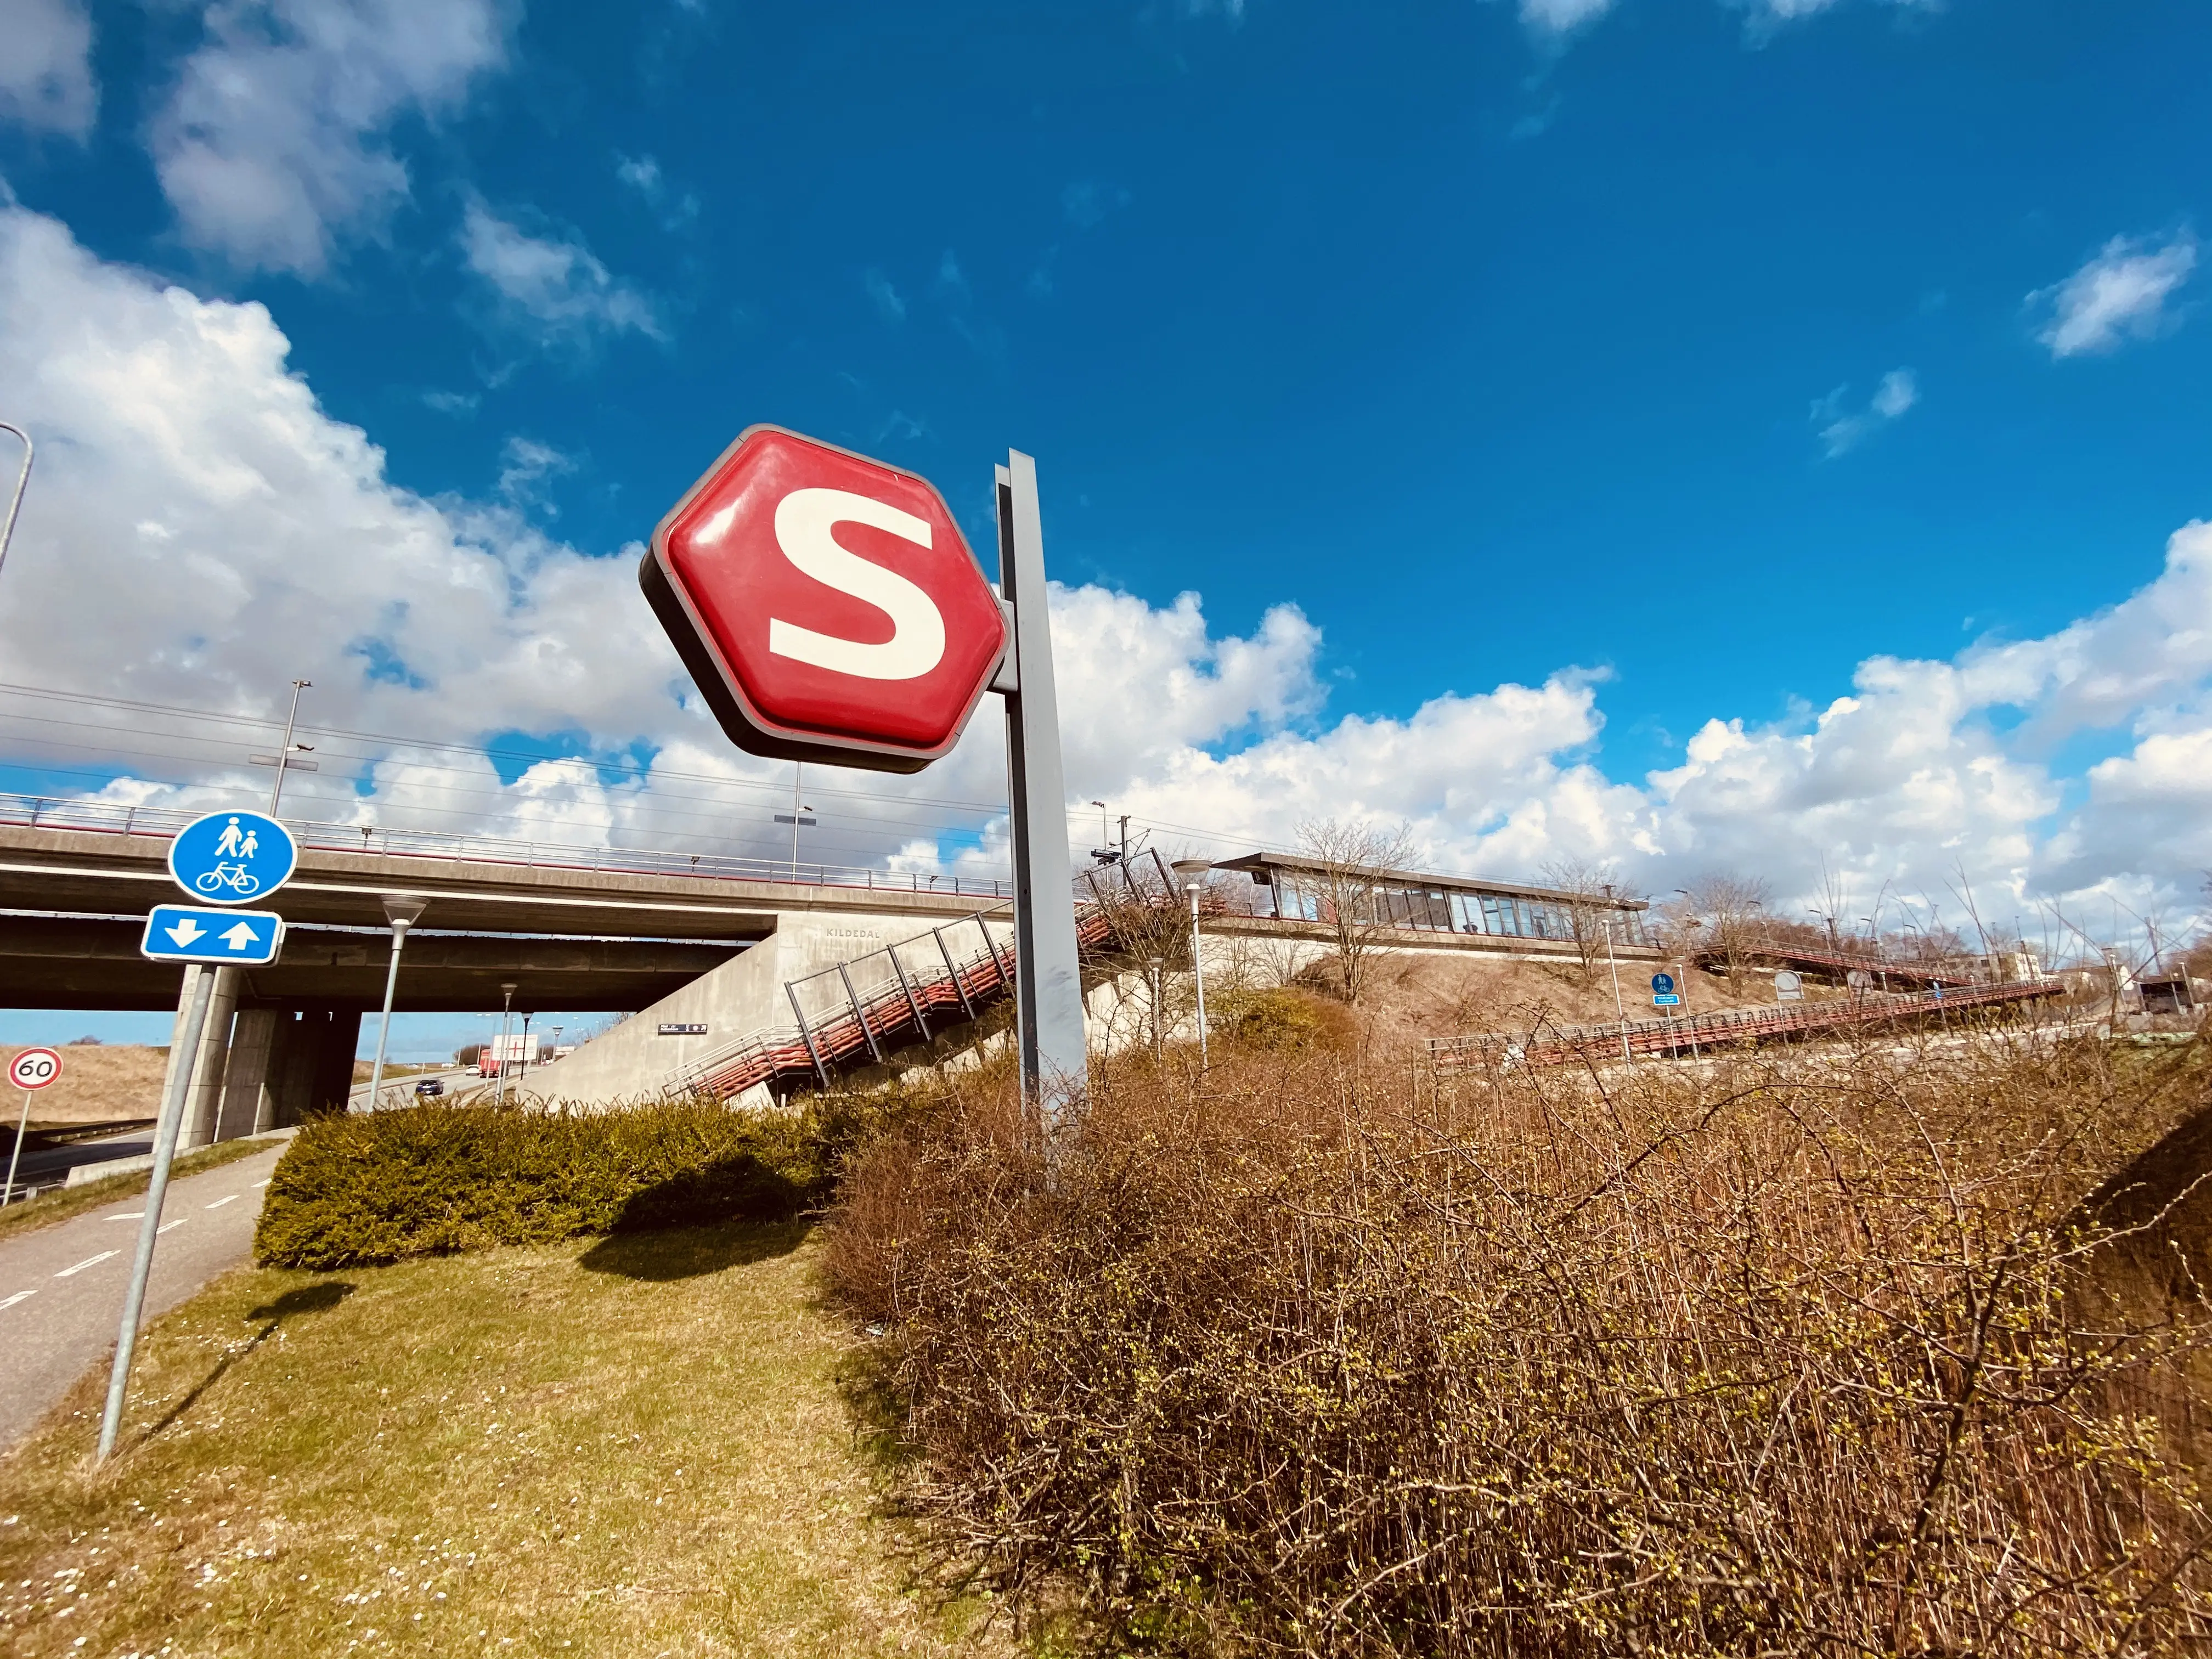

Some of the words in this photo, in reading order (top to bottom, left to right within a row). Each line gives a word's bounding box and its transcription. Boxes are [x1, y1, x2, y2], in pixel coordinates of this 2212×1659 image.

[769, 488, 946, 680] S
[826, 928, 880, 938] KILDEDAL
[19, 1060, 53, 1077] 60
